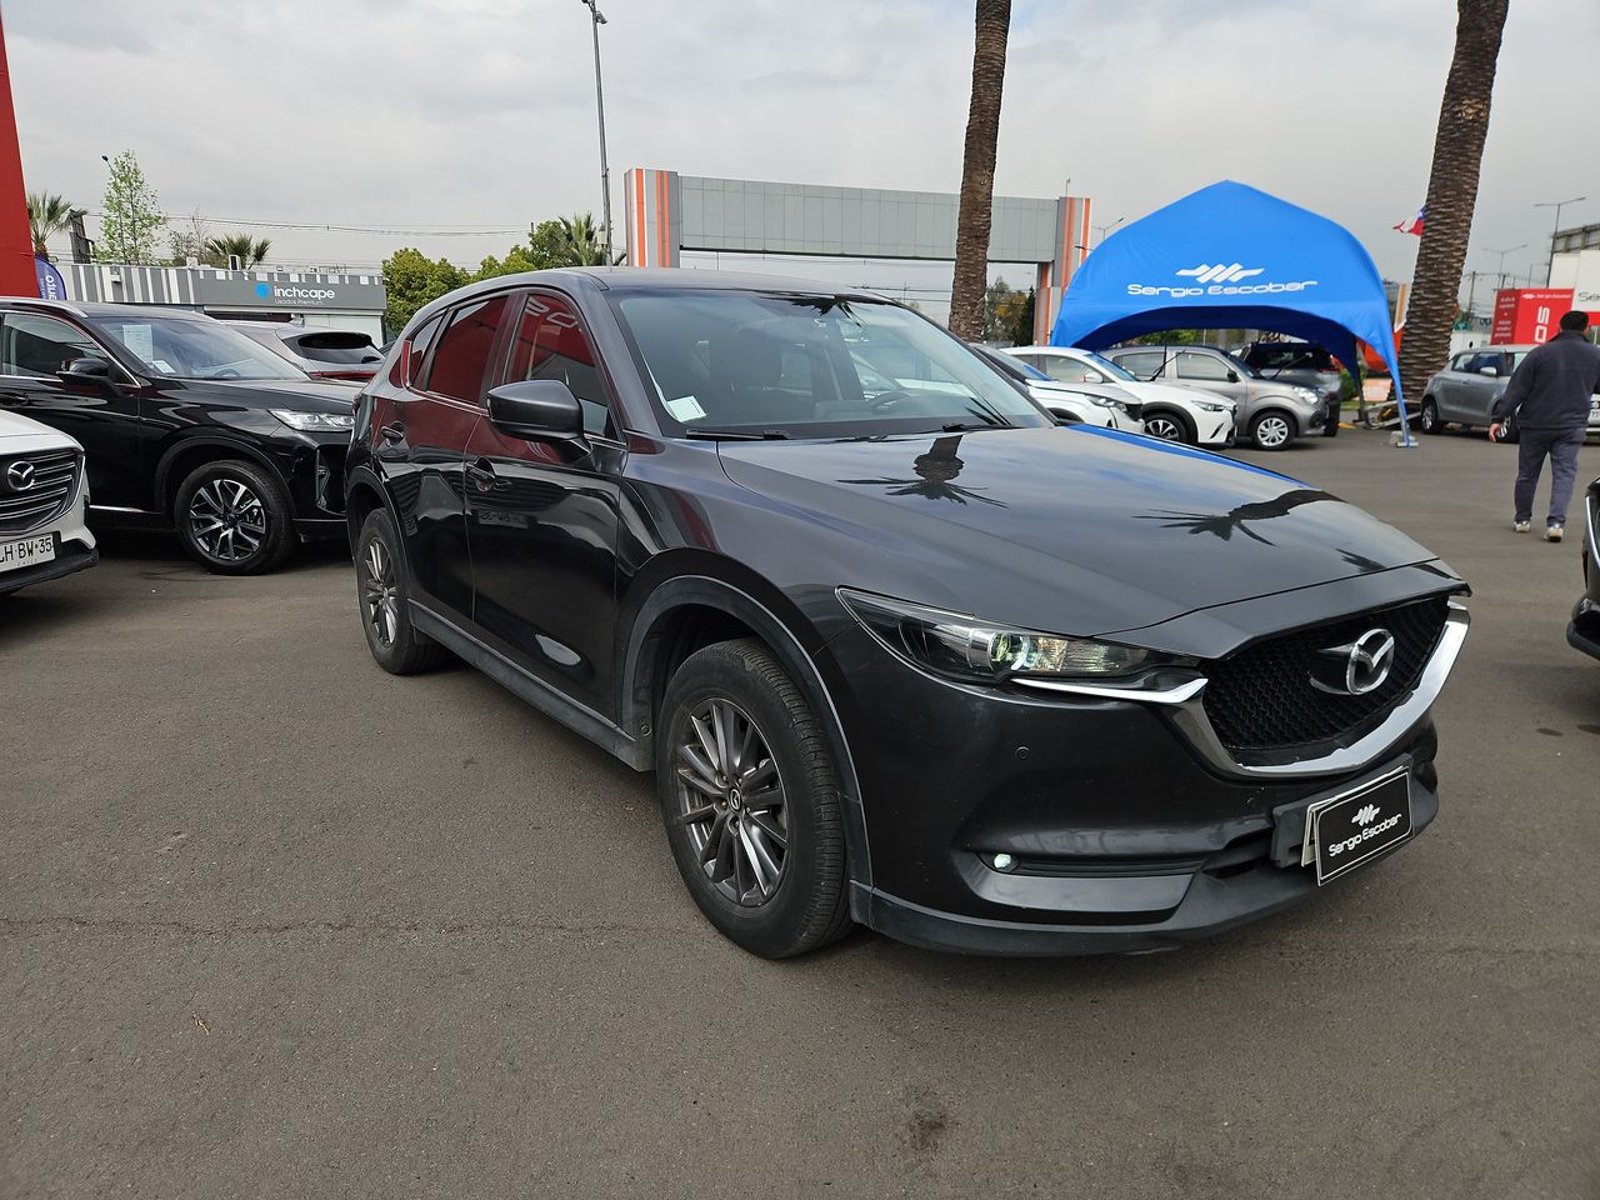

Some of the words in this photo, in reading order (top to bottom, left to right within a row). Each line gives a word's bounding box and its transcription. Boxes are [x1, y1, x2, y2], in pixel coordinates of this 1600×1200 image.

[274, 285, 336, 299] inchcape
[1127, 283, 1203, 297] Sergio
[1207, 280, 1318, 295] Escobar
[1328, 834, 1362, 857] Sergio
[1361, 813, 1402, 840] Escobar
